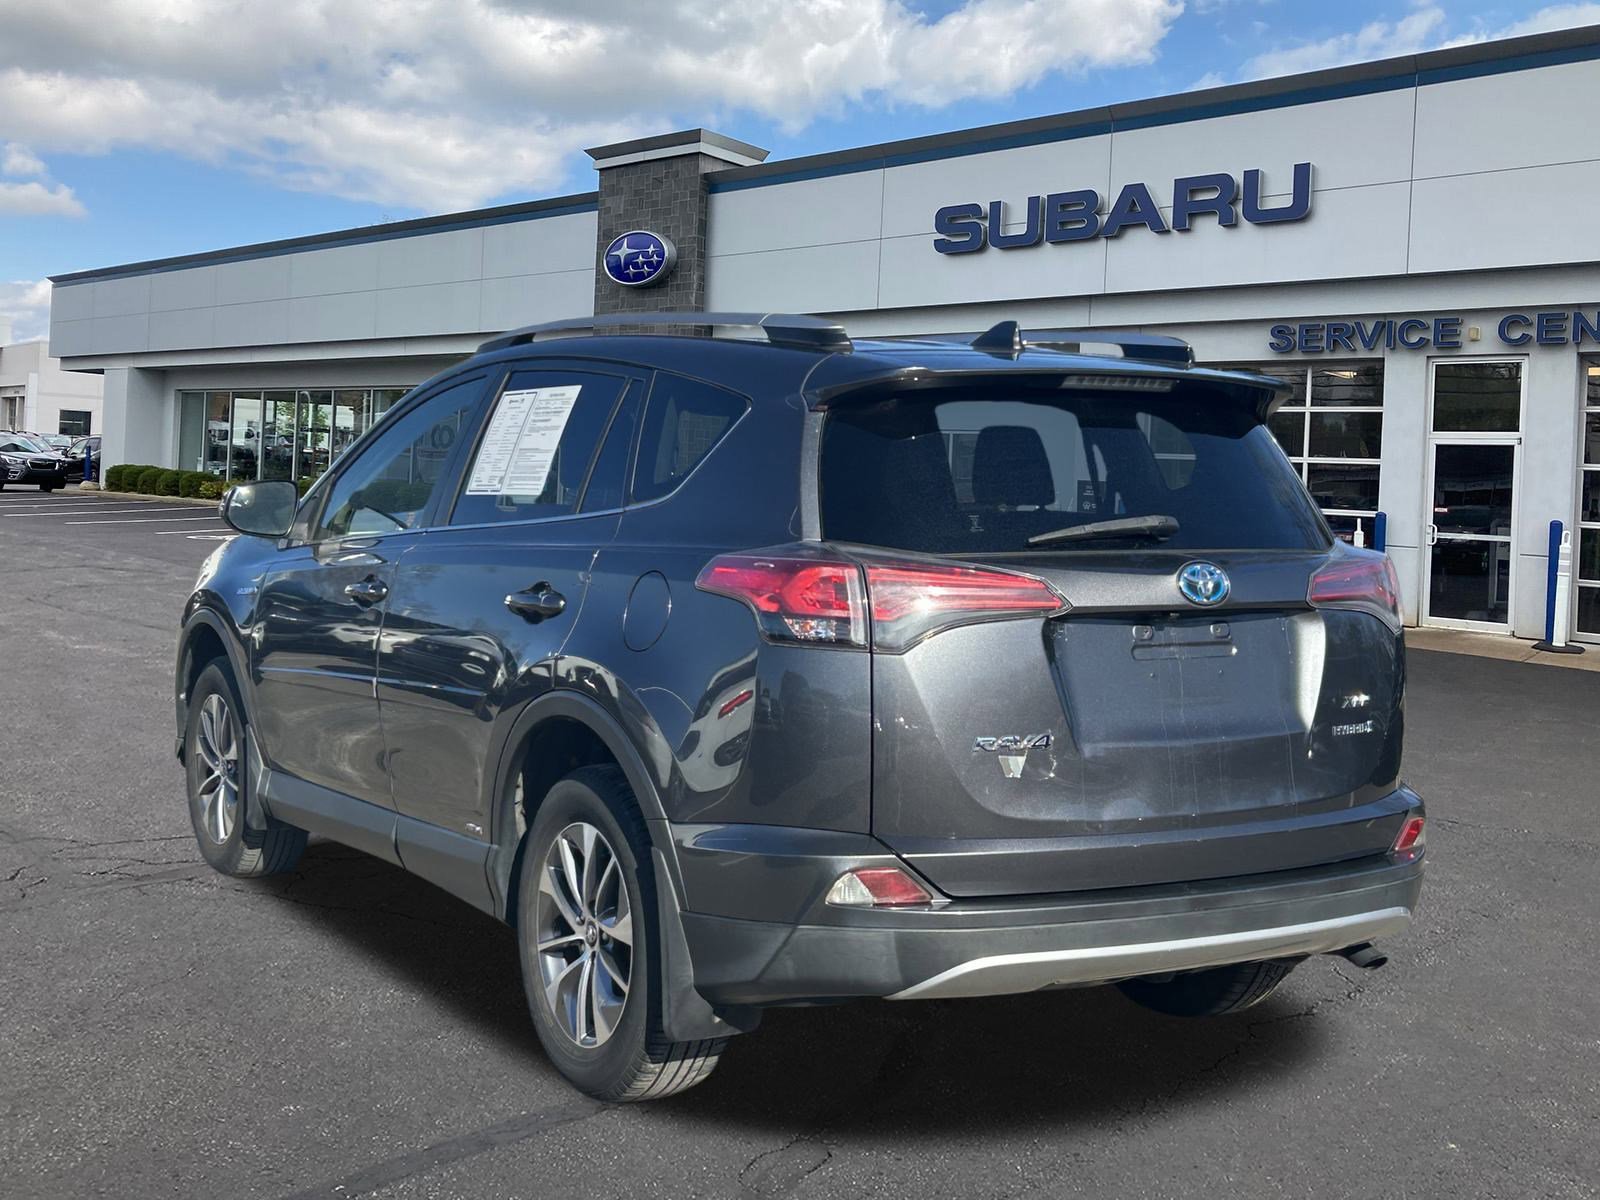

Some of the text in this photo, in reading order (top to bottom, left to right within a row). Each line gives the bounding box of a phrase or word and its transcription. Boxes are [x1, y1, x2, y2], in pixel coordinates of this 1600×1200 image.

[934, 162, 1313, 254] SUBARU
[1269, 311, 1600, 353] SERVICE CEN
[972, 732, 1053, 753] RAV4
